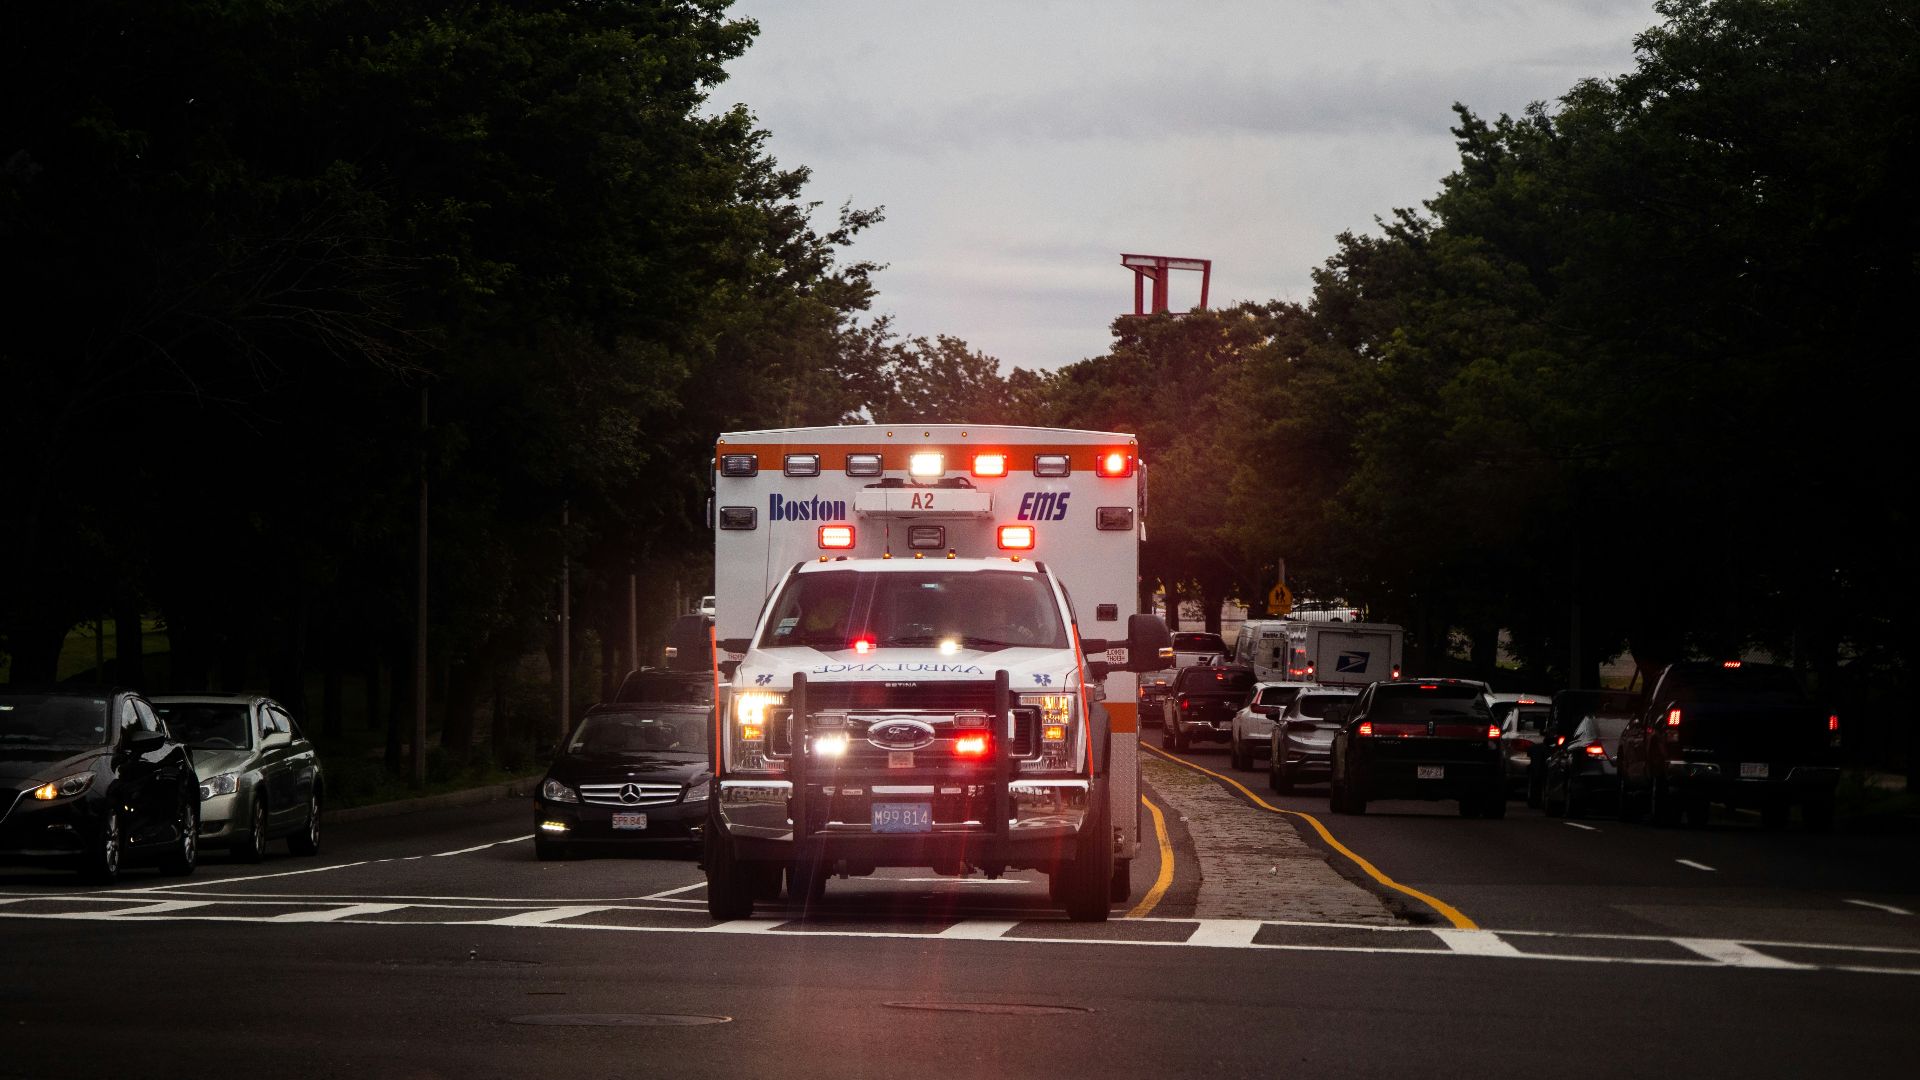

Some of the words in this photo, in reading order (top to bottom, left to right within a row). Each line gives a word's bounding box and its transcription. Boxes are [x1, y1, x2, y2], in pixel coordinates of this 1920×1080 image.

[769, 493, 846, 522] Boston
[911, 492, 934, 509] A2
[1017, 491, 1071, 521] EMS
[874, 810, 900, 826] M99
[903, 810, 929, 826] 814
